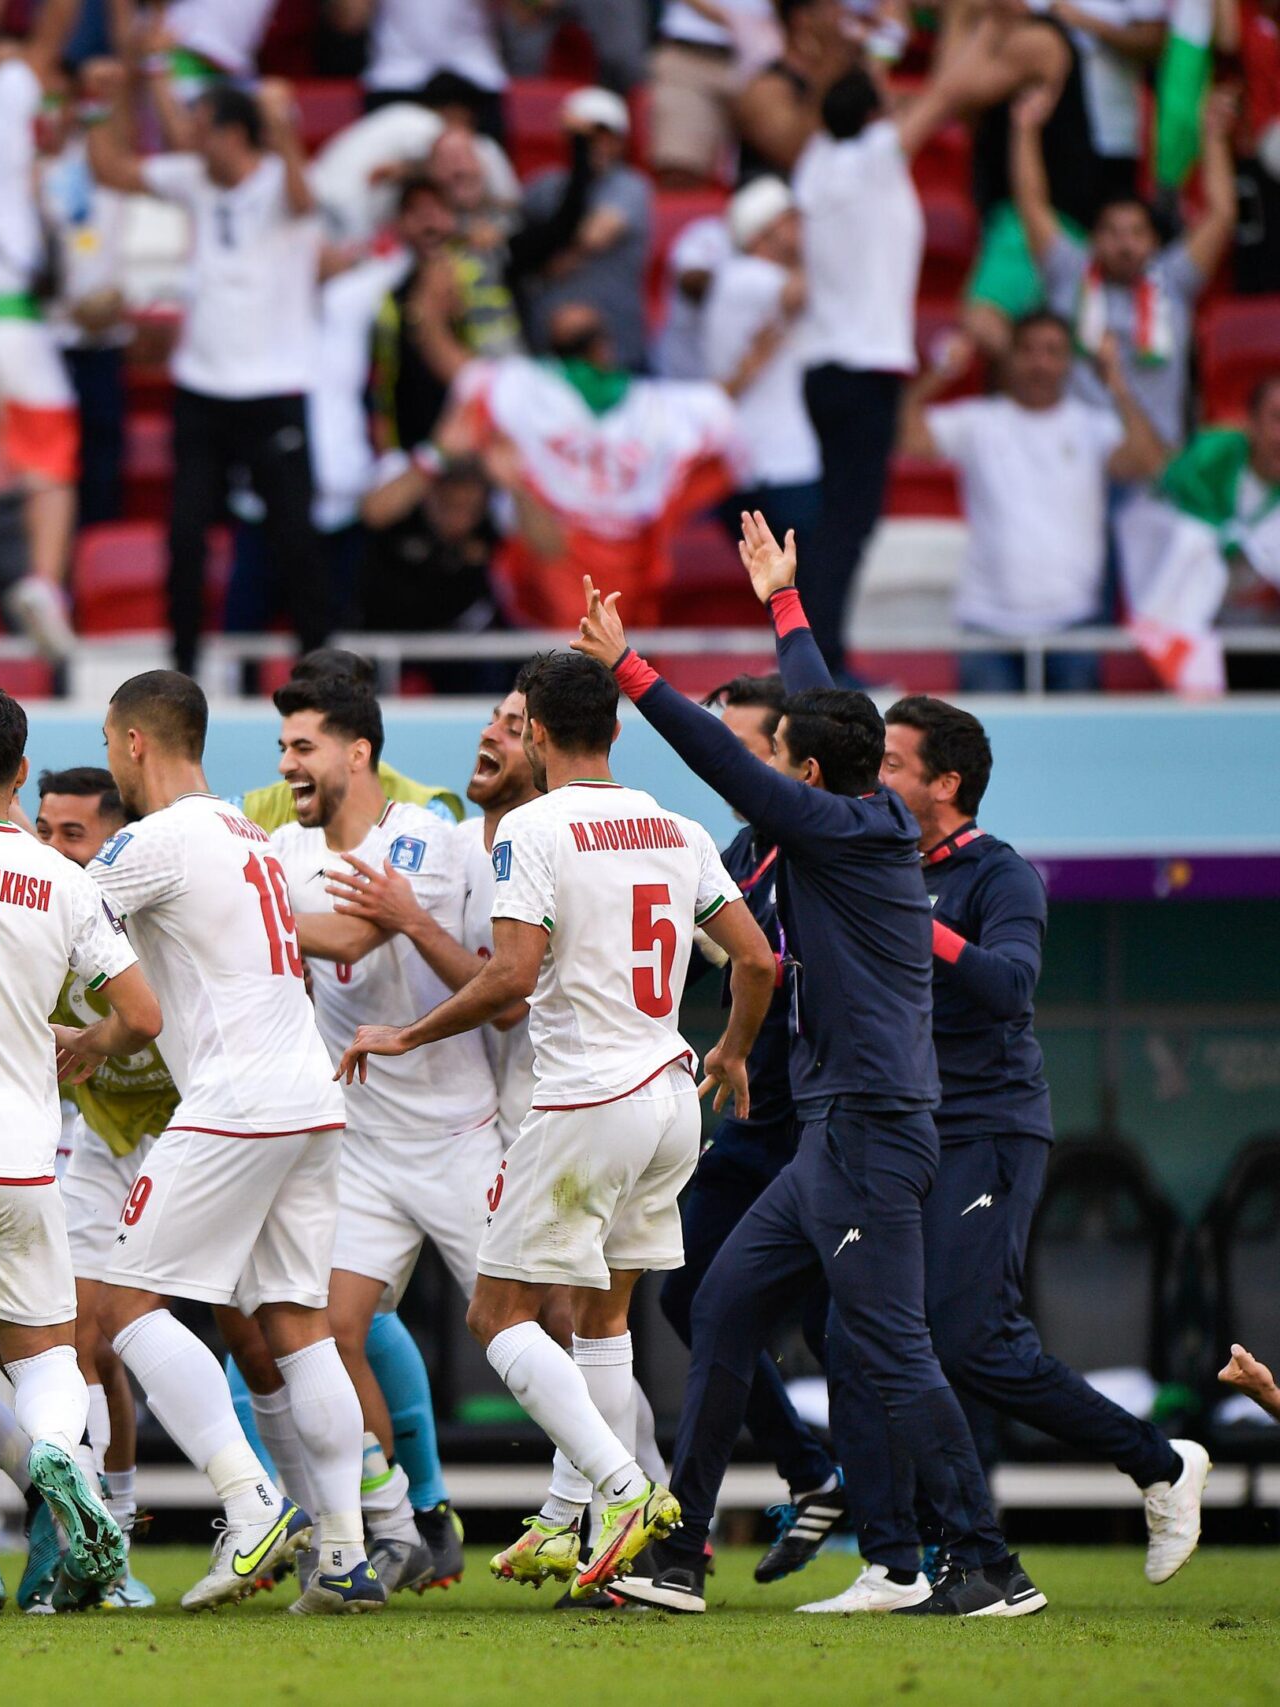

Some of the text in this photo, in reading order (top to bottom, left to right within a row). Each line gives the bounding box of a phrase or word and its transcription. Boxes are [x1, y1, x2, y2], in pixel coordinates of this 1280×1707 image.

[242, 851, 304, 979] 19
[631, 883, 677, 1019] 5
[120, 1173, 154, 1227] 9
